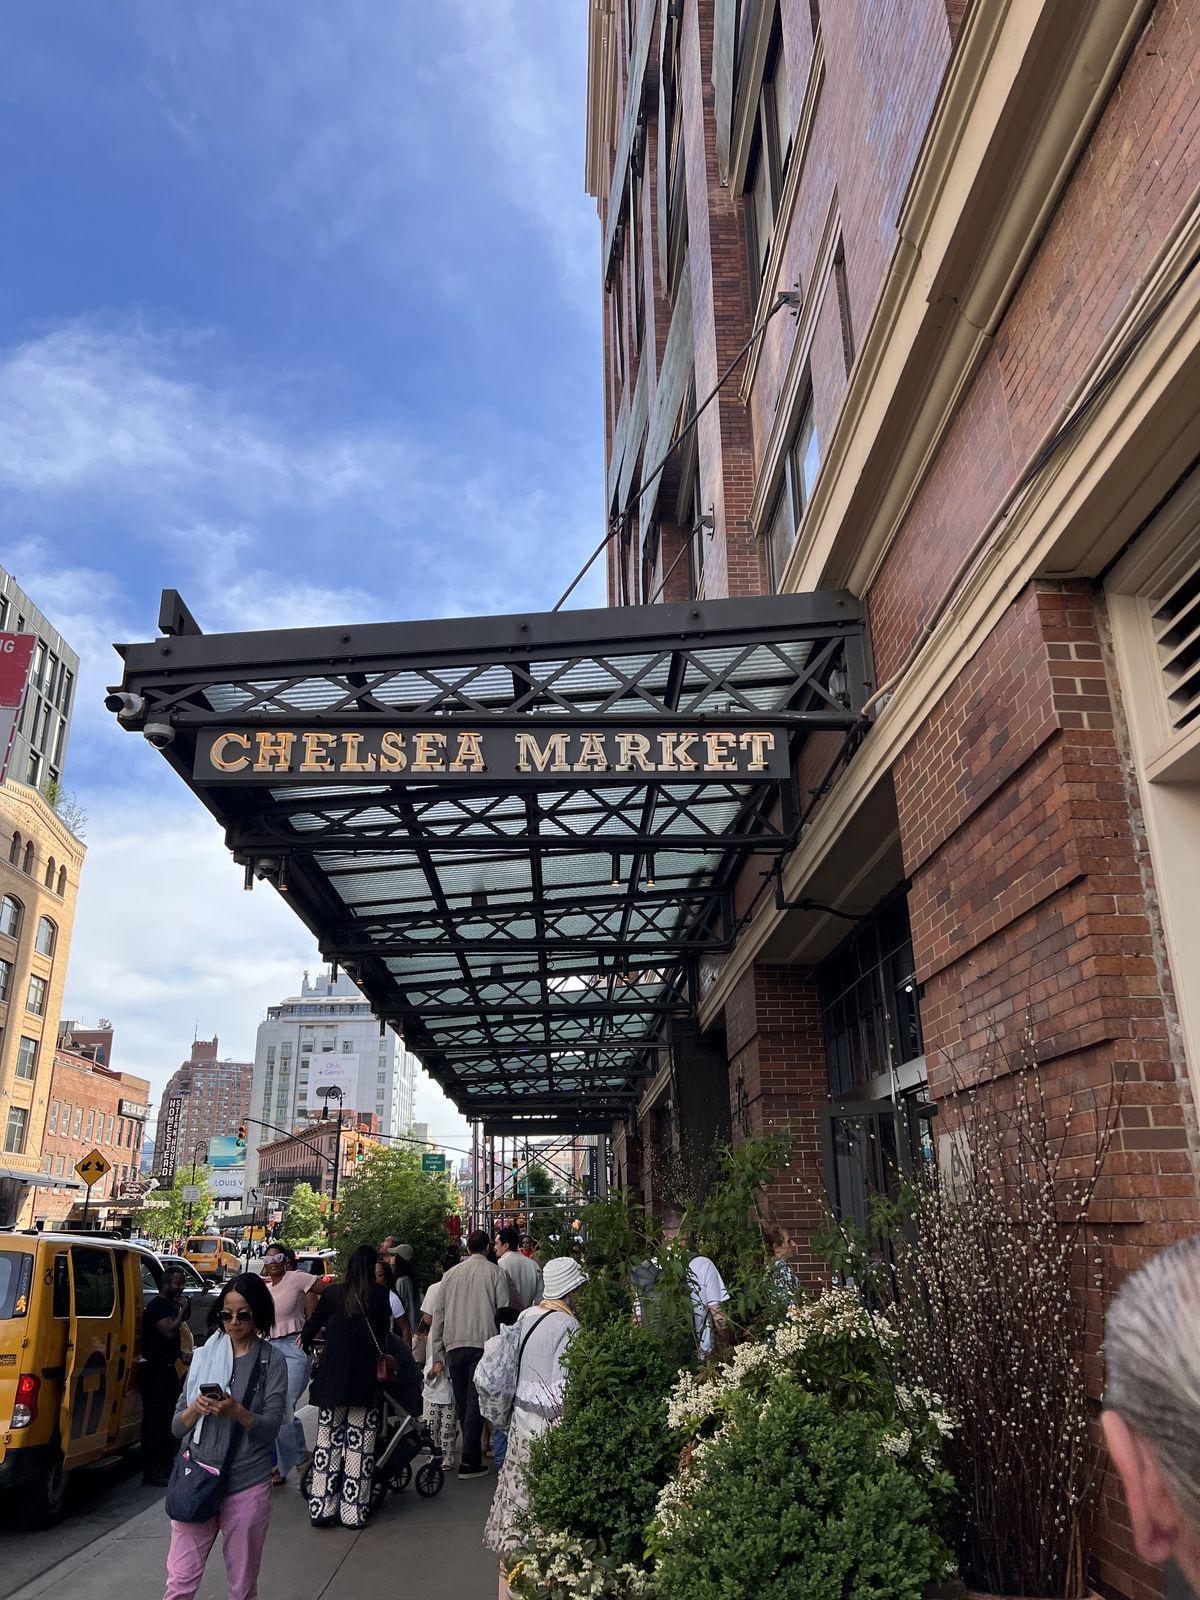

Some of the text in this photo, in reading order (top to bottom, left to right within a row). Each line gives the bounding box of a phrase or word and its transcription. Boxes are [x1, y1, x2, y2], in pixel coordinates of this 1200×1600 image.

[210, 732, 776, 773] CHELSEA MARKET
[162, 1099, 176, 1176] HOMESTEAD
[168, 1138, 177, 1176] HOUSE
[215, 1179, 237, 1187] LOUIS
